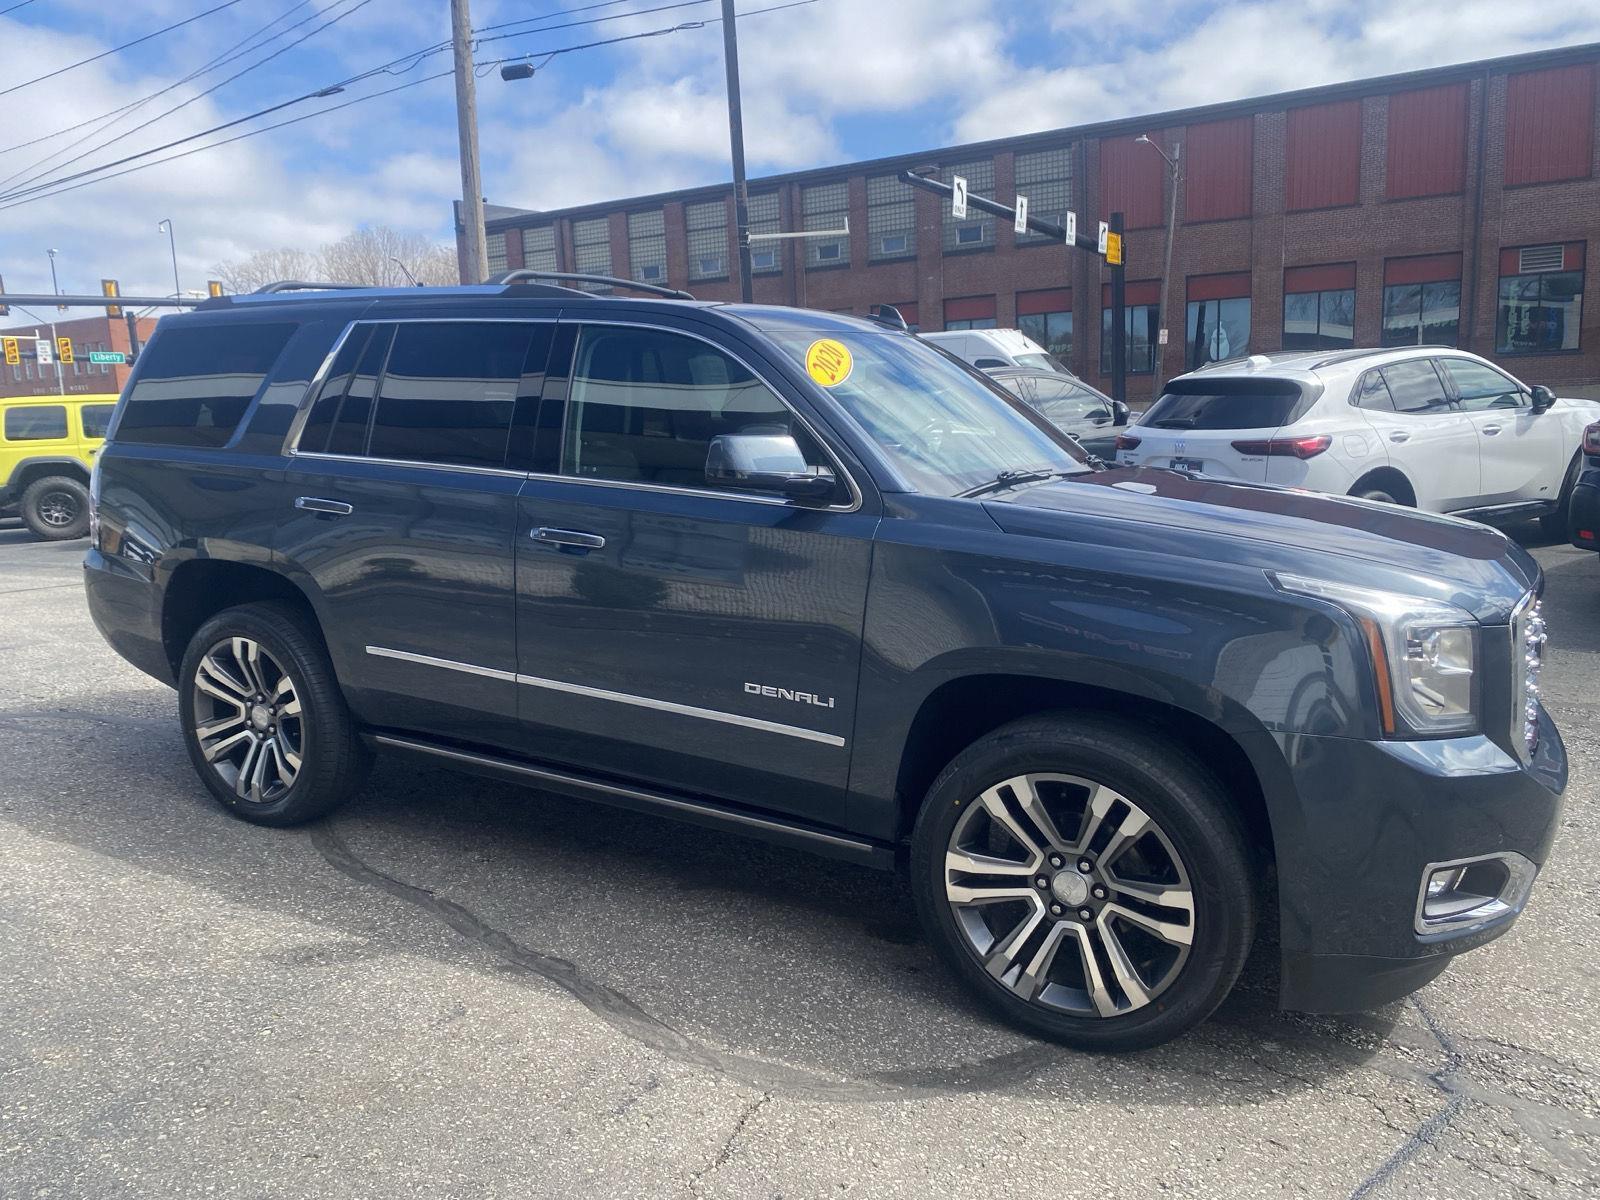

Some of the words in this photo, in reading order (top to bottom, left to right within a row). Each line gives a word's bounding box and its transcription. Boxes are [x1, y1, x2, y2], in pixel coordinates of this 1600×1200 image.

[94, 353, 121, 362] Liberty
[813, 343, 844, 381] 2020
[744, 682, 835, 708] DENALI
